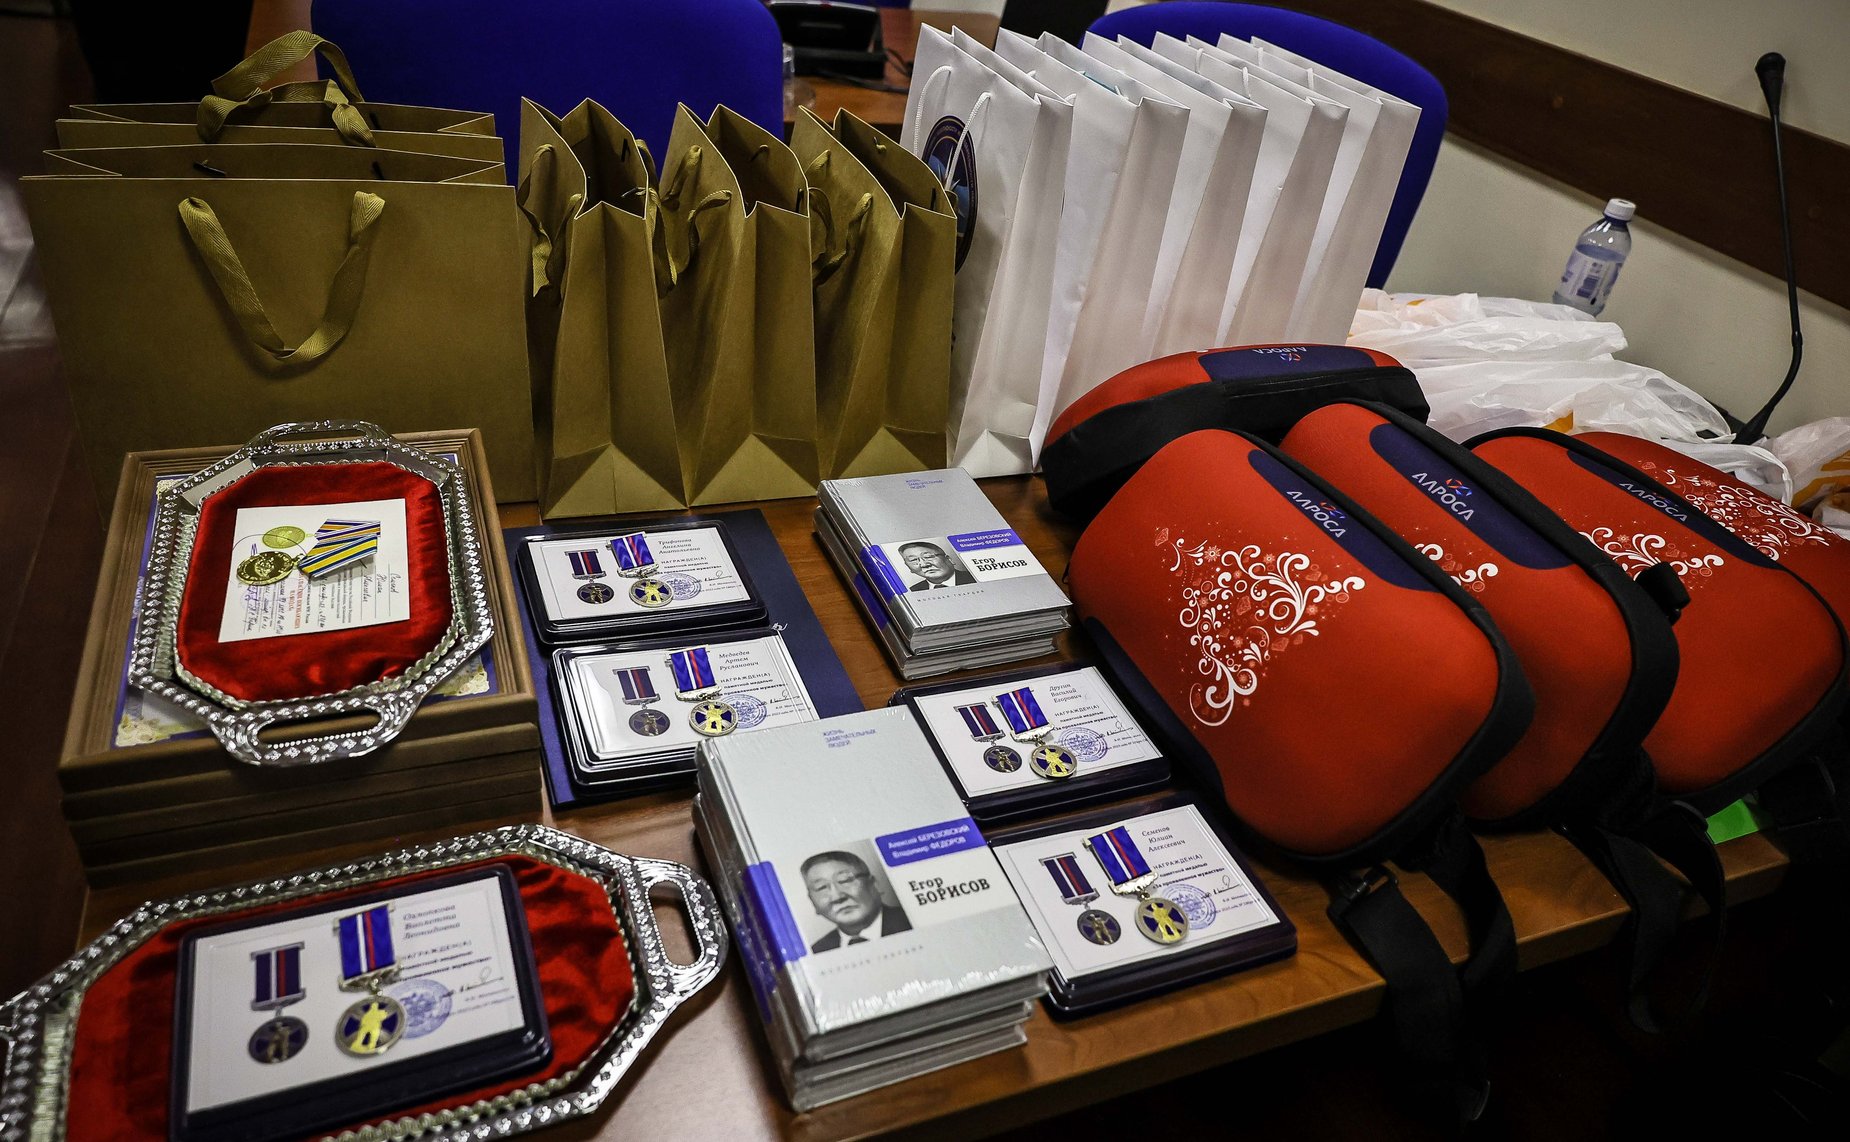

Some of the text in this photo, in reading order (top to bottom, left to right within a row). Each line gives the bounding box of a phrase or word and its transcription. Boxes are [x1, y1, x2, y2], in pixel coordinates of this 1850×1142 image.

[972, 557, 996, 565] Егор
[976, 559, 1028, 572] БОРИСОВ
[719, 650, 750, 659] Медведев
[719, 661, 759, 671] Русланович
[1050, 688, 1077, 698] Василий
[1054, 705, 1100, 717] НАГРАЖДЕН(А)
[1141, 825, 1170, 837] Семенов
[1148, 834, 1174, 844] Юлиан
[1148, 839, 1186, 853] Алексеевич
[1152, 853, 1203, 870] НАГРАЖДЕН(А)
[908, 877, 943, 892] Егор
[915, 878, 990, 906] БОРИСОВ
